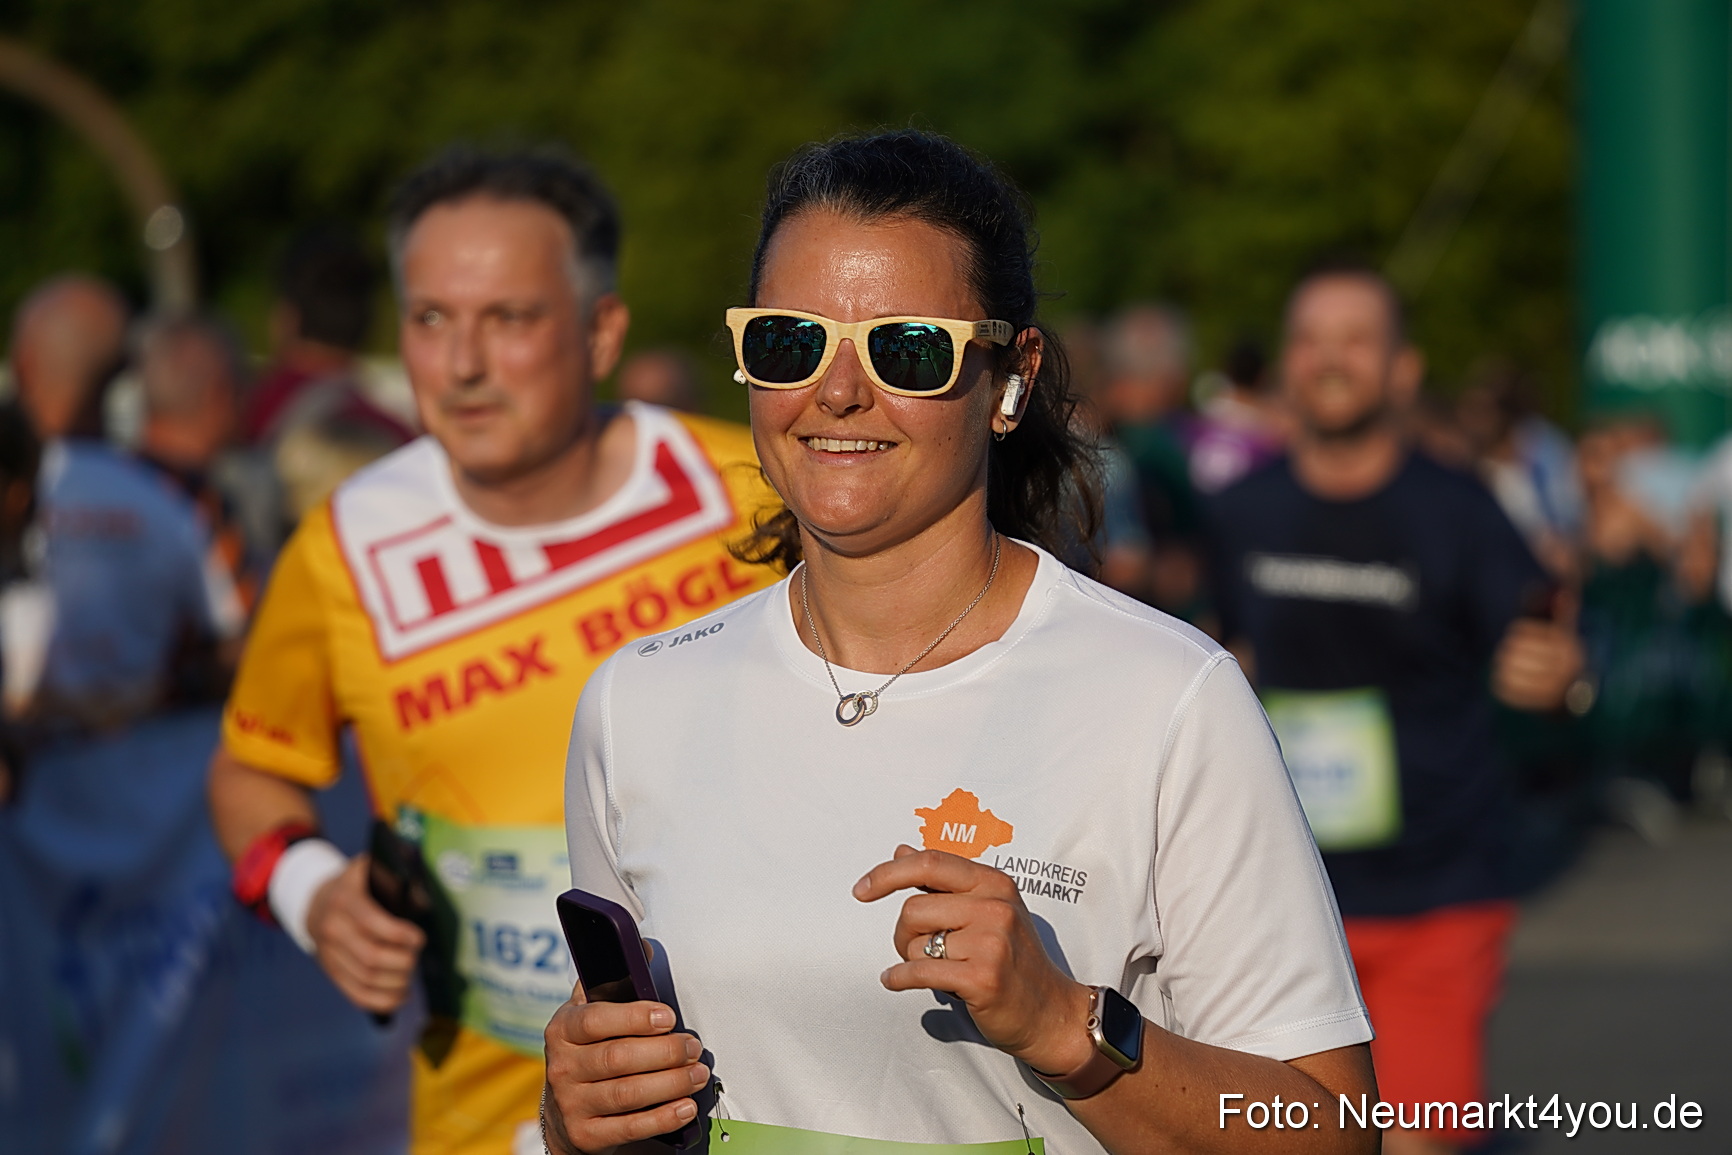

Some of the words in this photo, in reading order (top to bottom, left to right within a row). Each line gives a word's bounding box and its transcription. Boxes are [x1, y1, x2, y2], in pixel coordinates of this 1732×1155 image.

[393, 633, 556, 733] MAX
[577, 555, 755, 656] BÖGL
[668, 622, 725, 648] JAKO
[940, 822, 977, 844] NM
[994, 854, 1088, 887] LANDKREIS
[472, 922, 570, 972] 162
